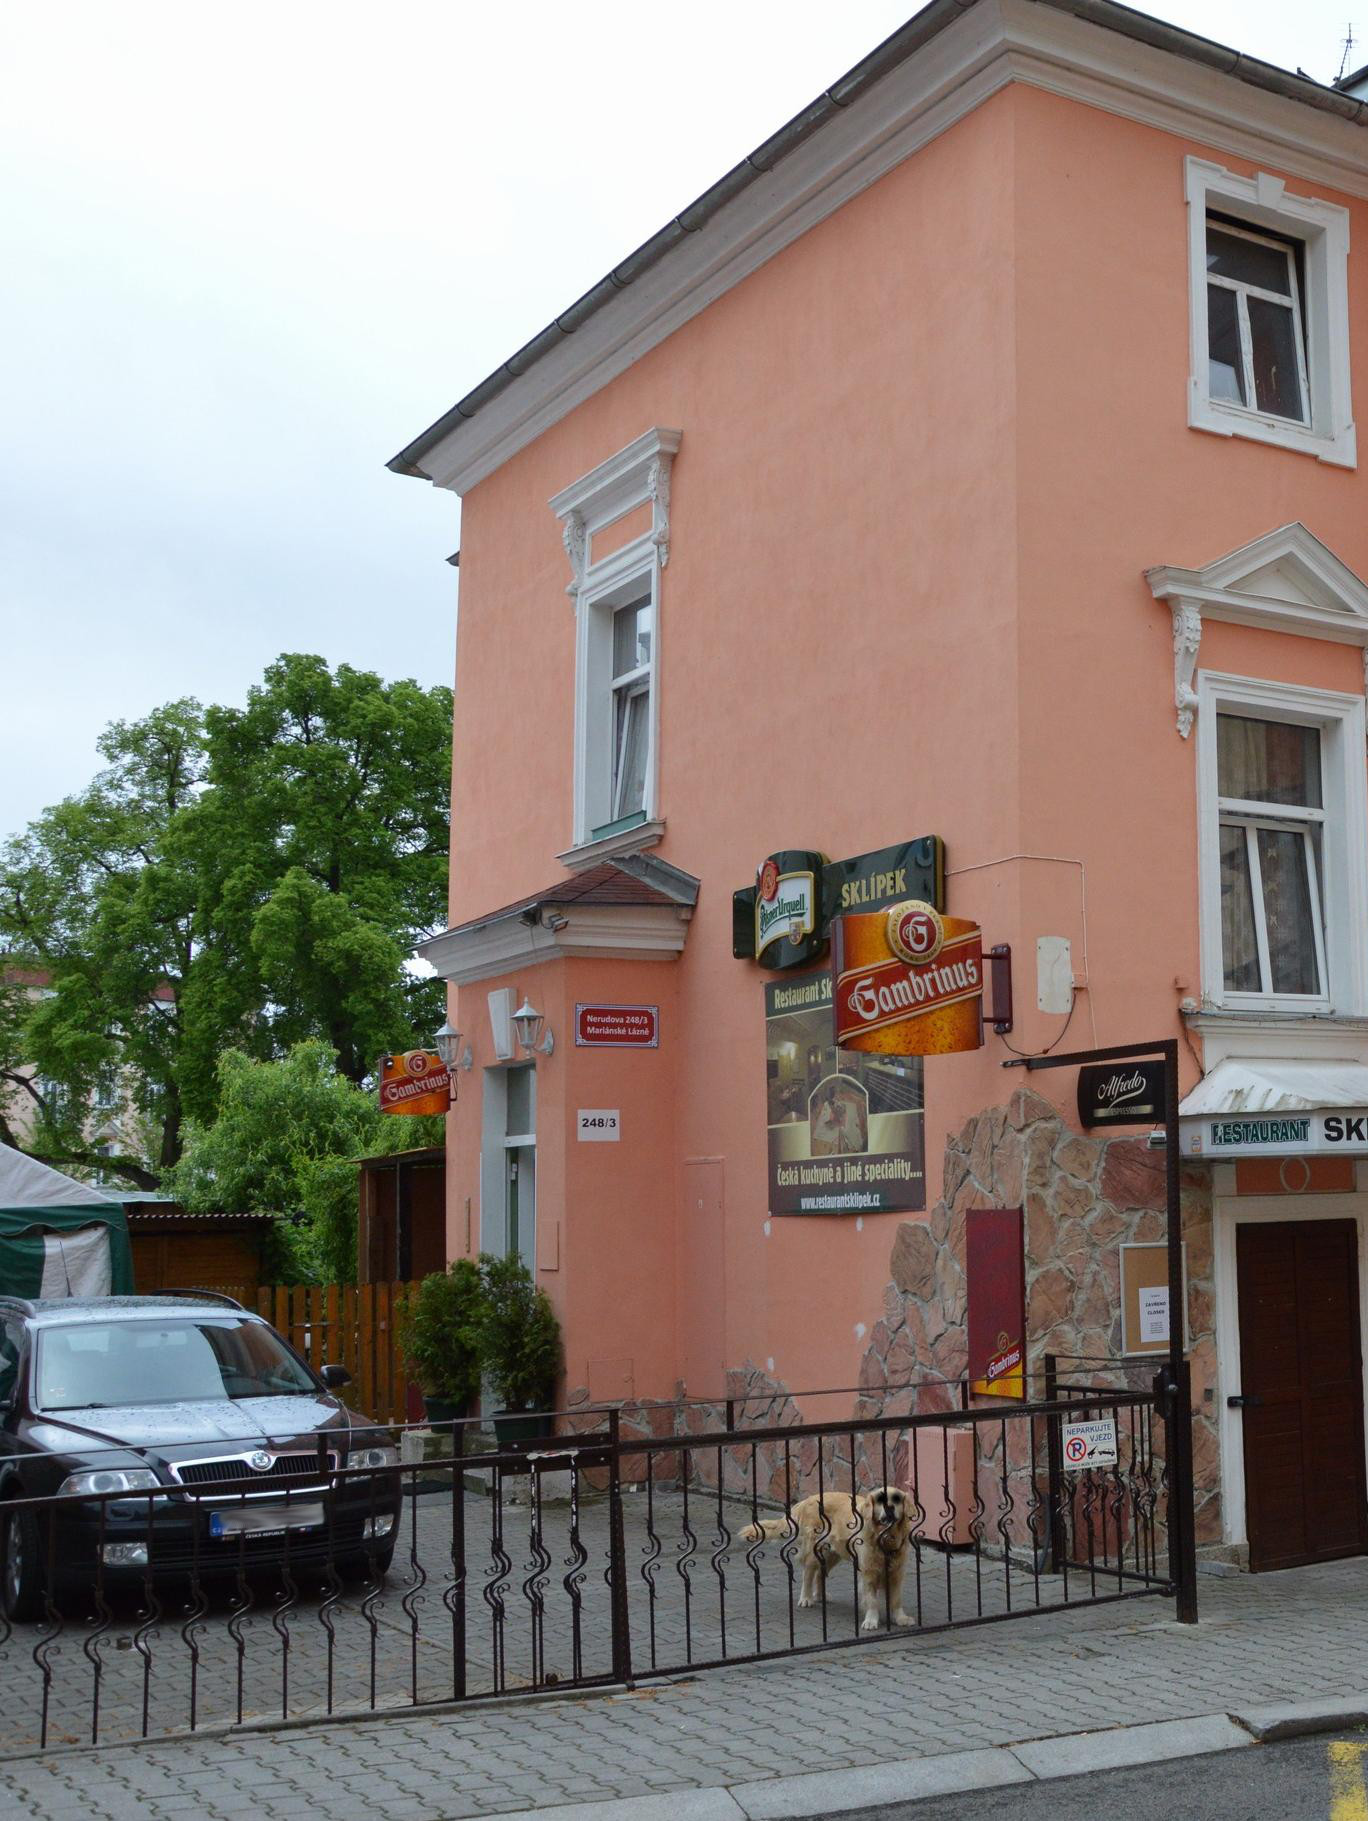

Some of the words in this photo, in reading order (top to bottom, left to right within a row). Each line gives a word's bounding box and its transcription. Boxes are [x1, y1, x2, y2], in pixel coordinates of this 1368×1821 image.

[841, 868, 907, 908] SKLÍPEK
[777, 893, 805, 921] Urquell
[774, 985, 819, 1009] Restaurant
[848, 959, 979, 1020] Gambrinus
[586, 1015, 624, 1023] Nerudova
[625, 1016, 648, 1025] 248/3
[586, 1026, 626, 1035] Mariánské
[628, 1027, 649, 1036] Lázně
[384, 1073, 449, 1100] Gambrinus
[1097, 1070, 1147, 1103] Alfredo
[582, 1117, 616, 1128] 248/3
[1211, 1118, 1310, 1145] RESTAURANT
[777, 1164, 798, 1186] Česká
[836, 1167, 842, 1182] a
[843, 1161, 862, 1184] jiné
[801, 1192, 880, 1209] www.restaurantsklipek.cz
[1067, 1423, 1111, 1436] NEPARKUJTE
[1090, 1432, 1112, 1442] VJEZD
